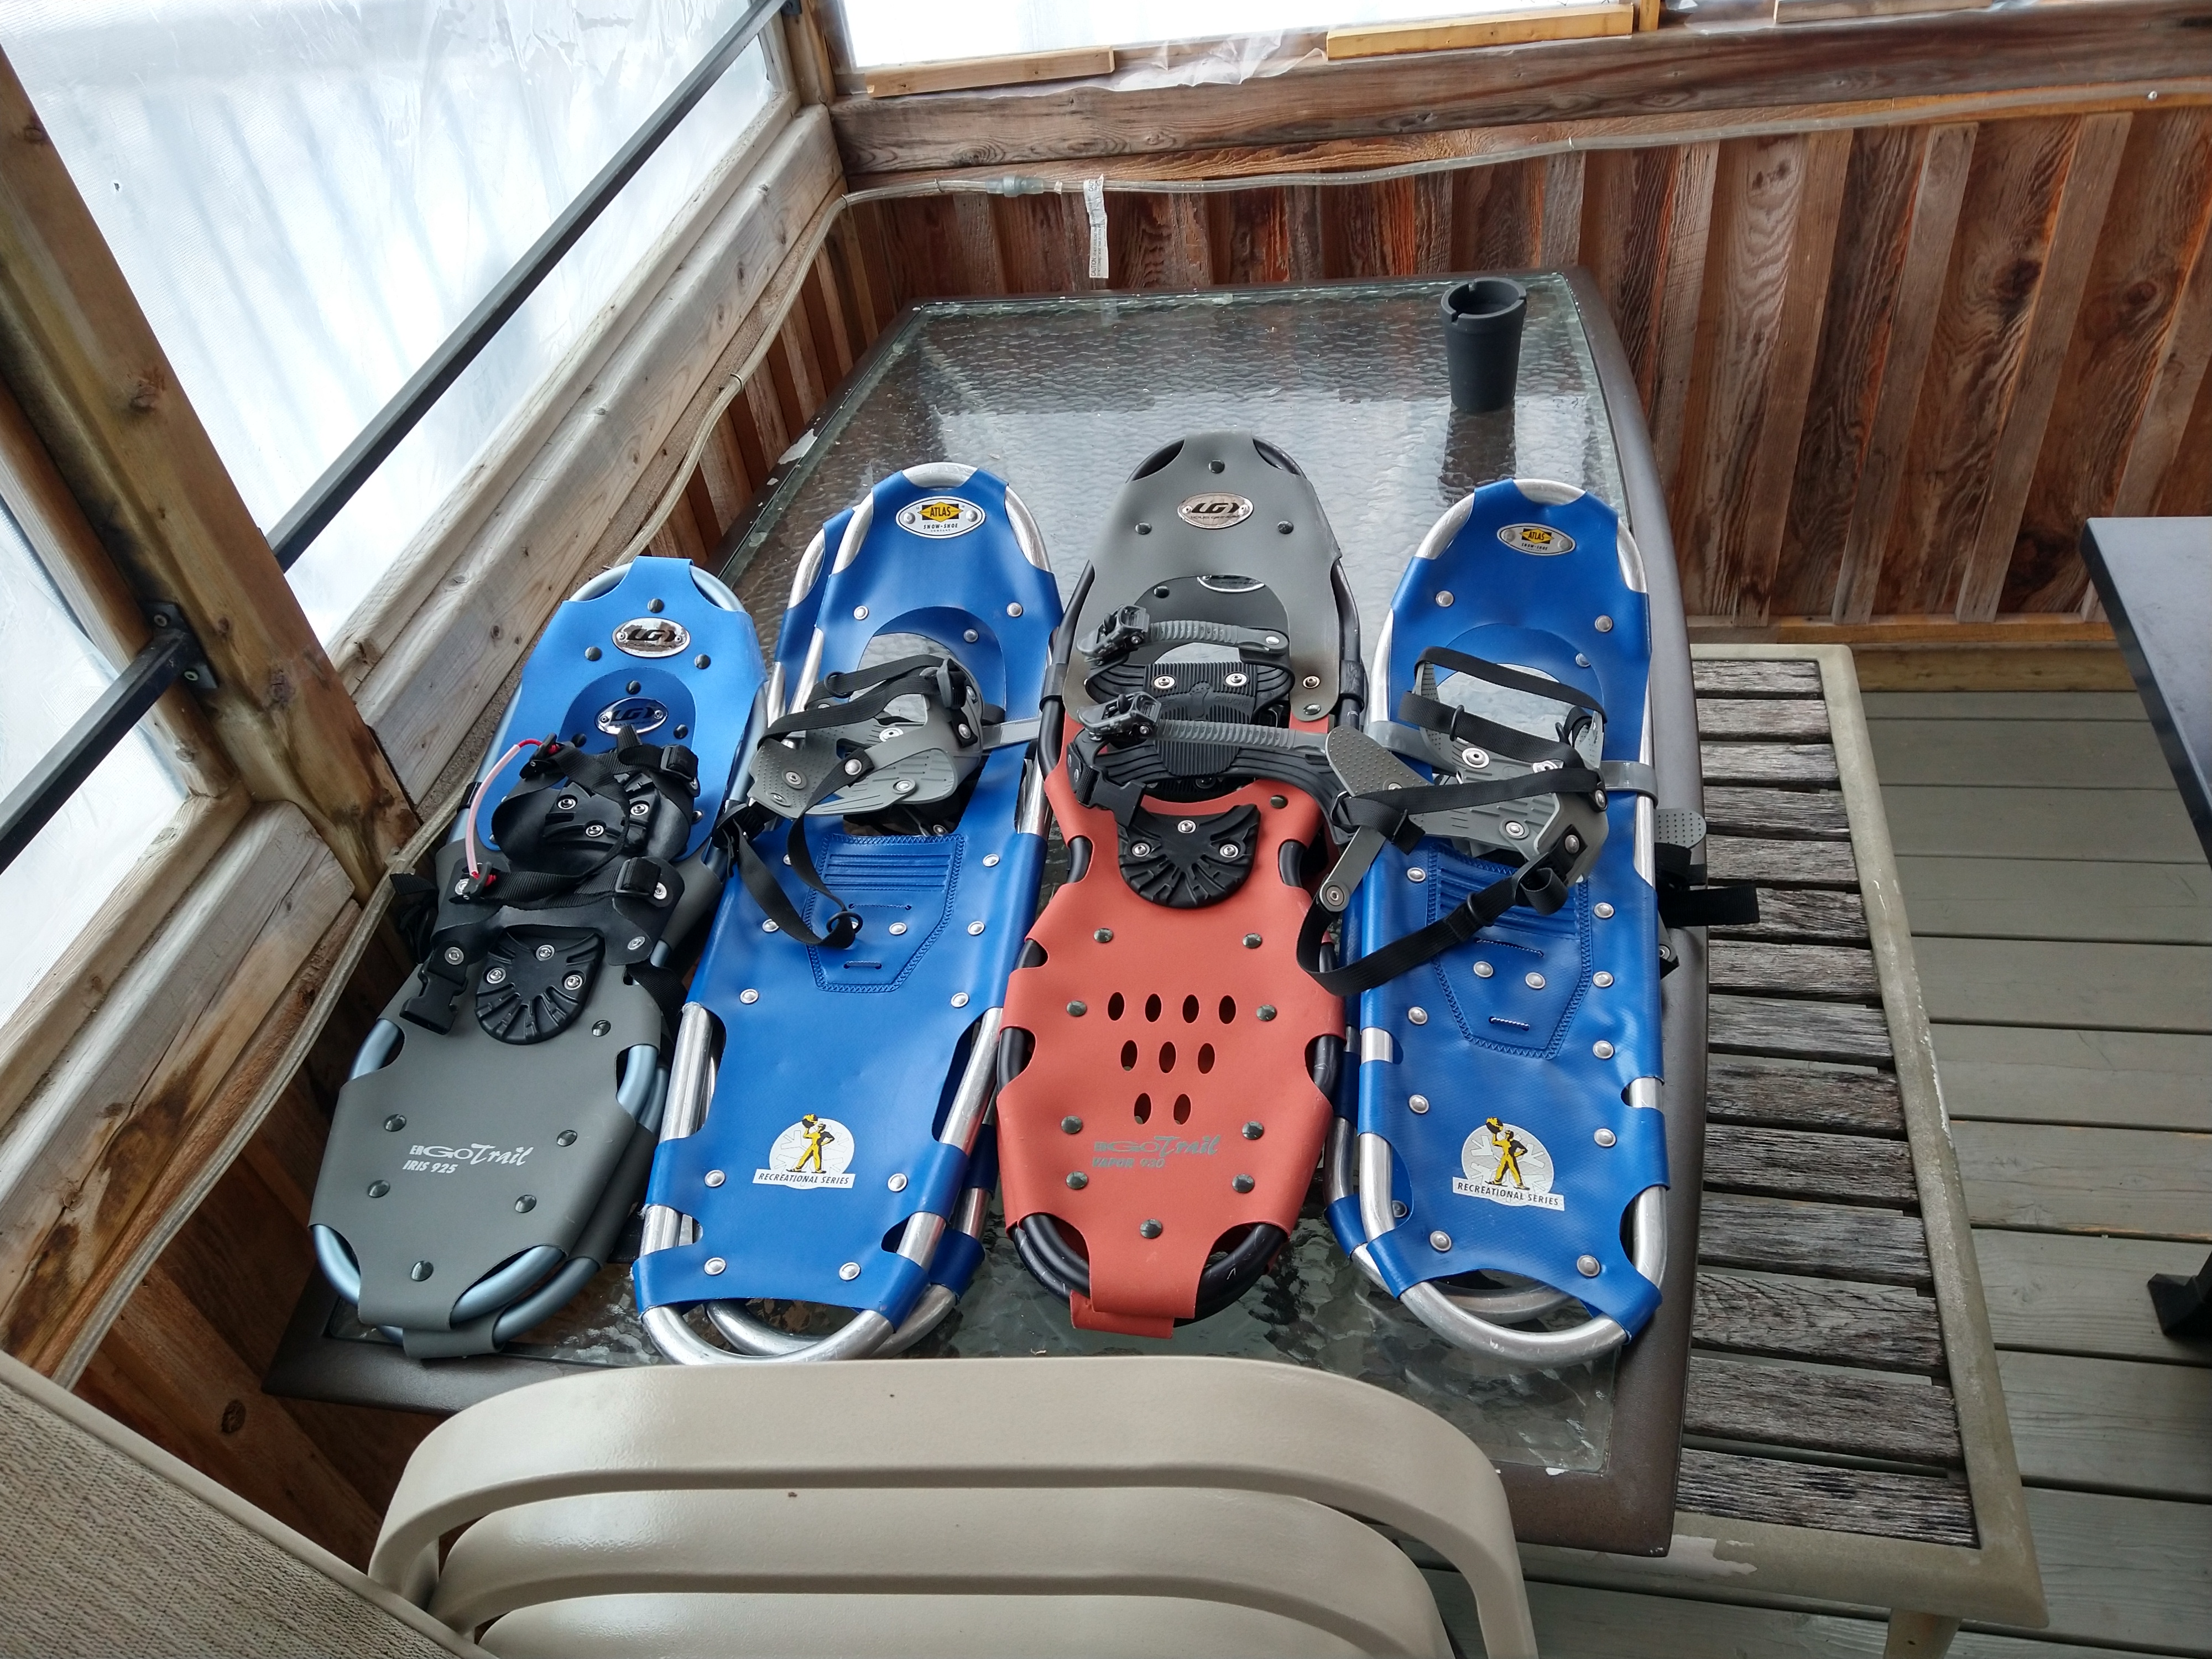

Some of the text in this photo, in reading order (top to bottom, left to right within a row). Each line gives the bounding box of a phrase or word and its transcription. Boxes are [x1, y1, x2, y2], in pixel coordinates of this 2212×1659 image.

[930, 507, 951, 517] ATLAS
[1528, 531, 1545, 541] ATLAS
[402, 1160, 458, 1173] IRIS 925
[1139, 1158, 1165, 1168] 930
[758, 1173, 849, 1185] RECREATIONAL SERIES
[1458, 1182, 1558, 1206] RECREATIONAL SERIES
